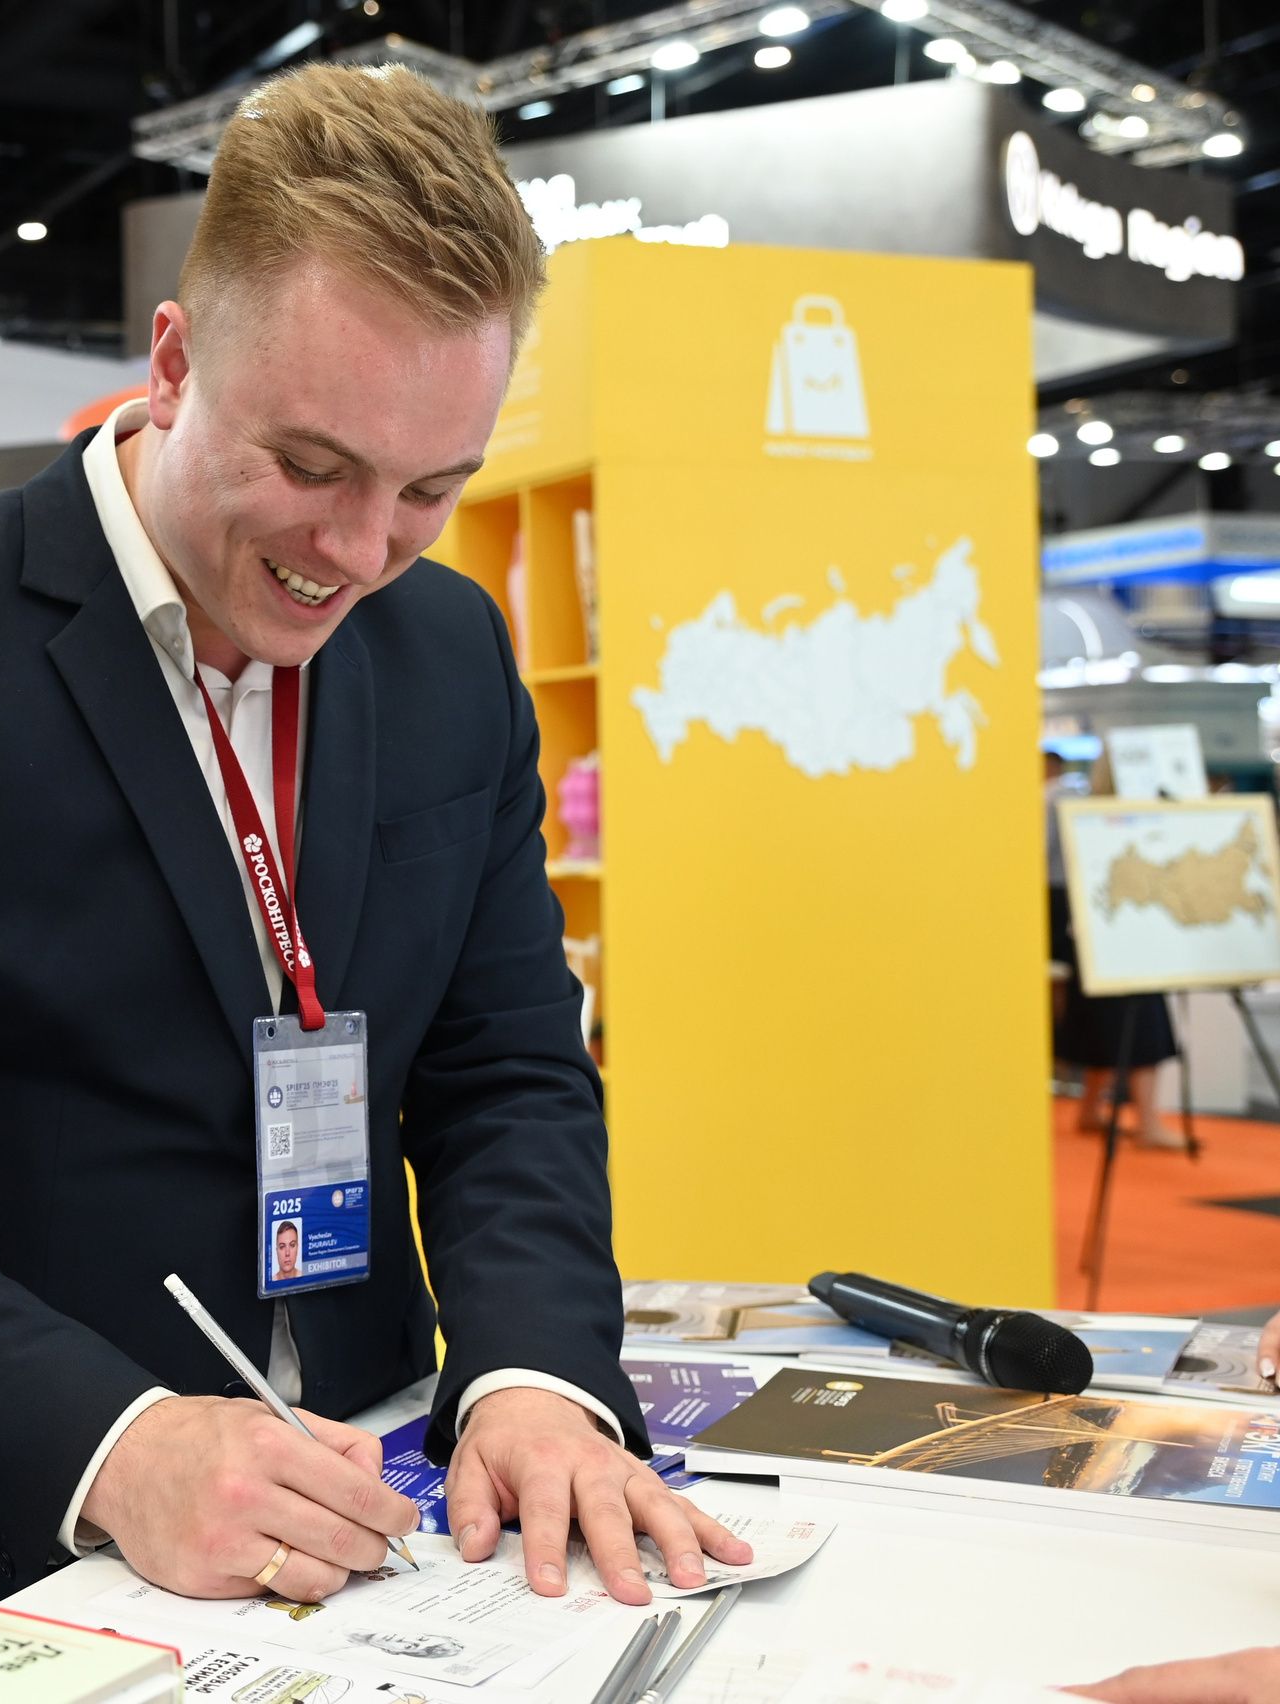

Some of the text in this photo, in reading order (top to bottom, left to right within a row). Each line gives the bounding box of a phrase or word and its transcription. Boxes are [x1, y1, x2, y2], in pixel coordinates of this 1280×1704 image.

[250, 852, 295, 972] РОСКОНГРЕСС
[272, 1198, 302, 1216] 2025
[308, 1239, 338, 1250] ZHURAVLEV
[307, 1258, 348, 1273] EXHIBITOR
[221, 1651, 241, 1659] К
[195, 1659, 250, 1694] ЛЮБОВЬЮ
